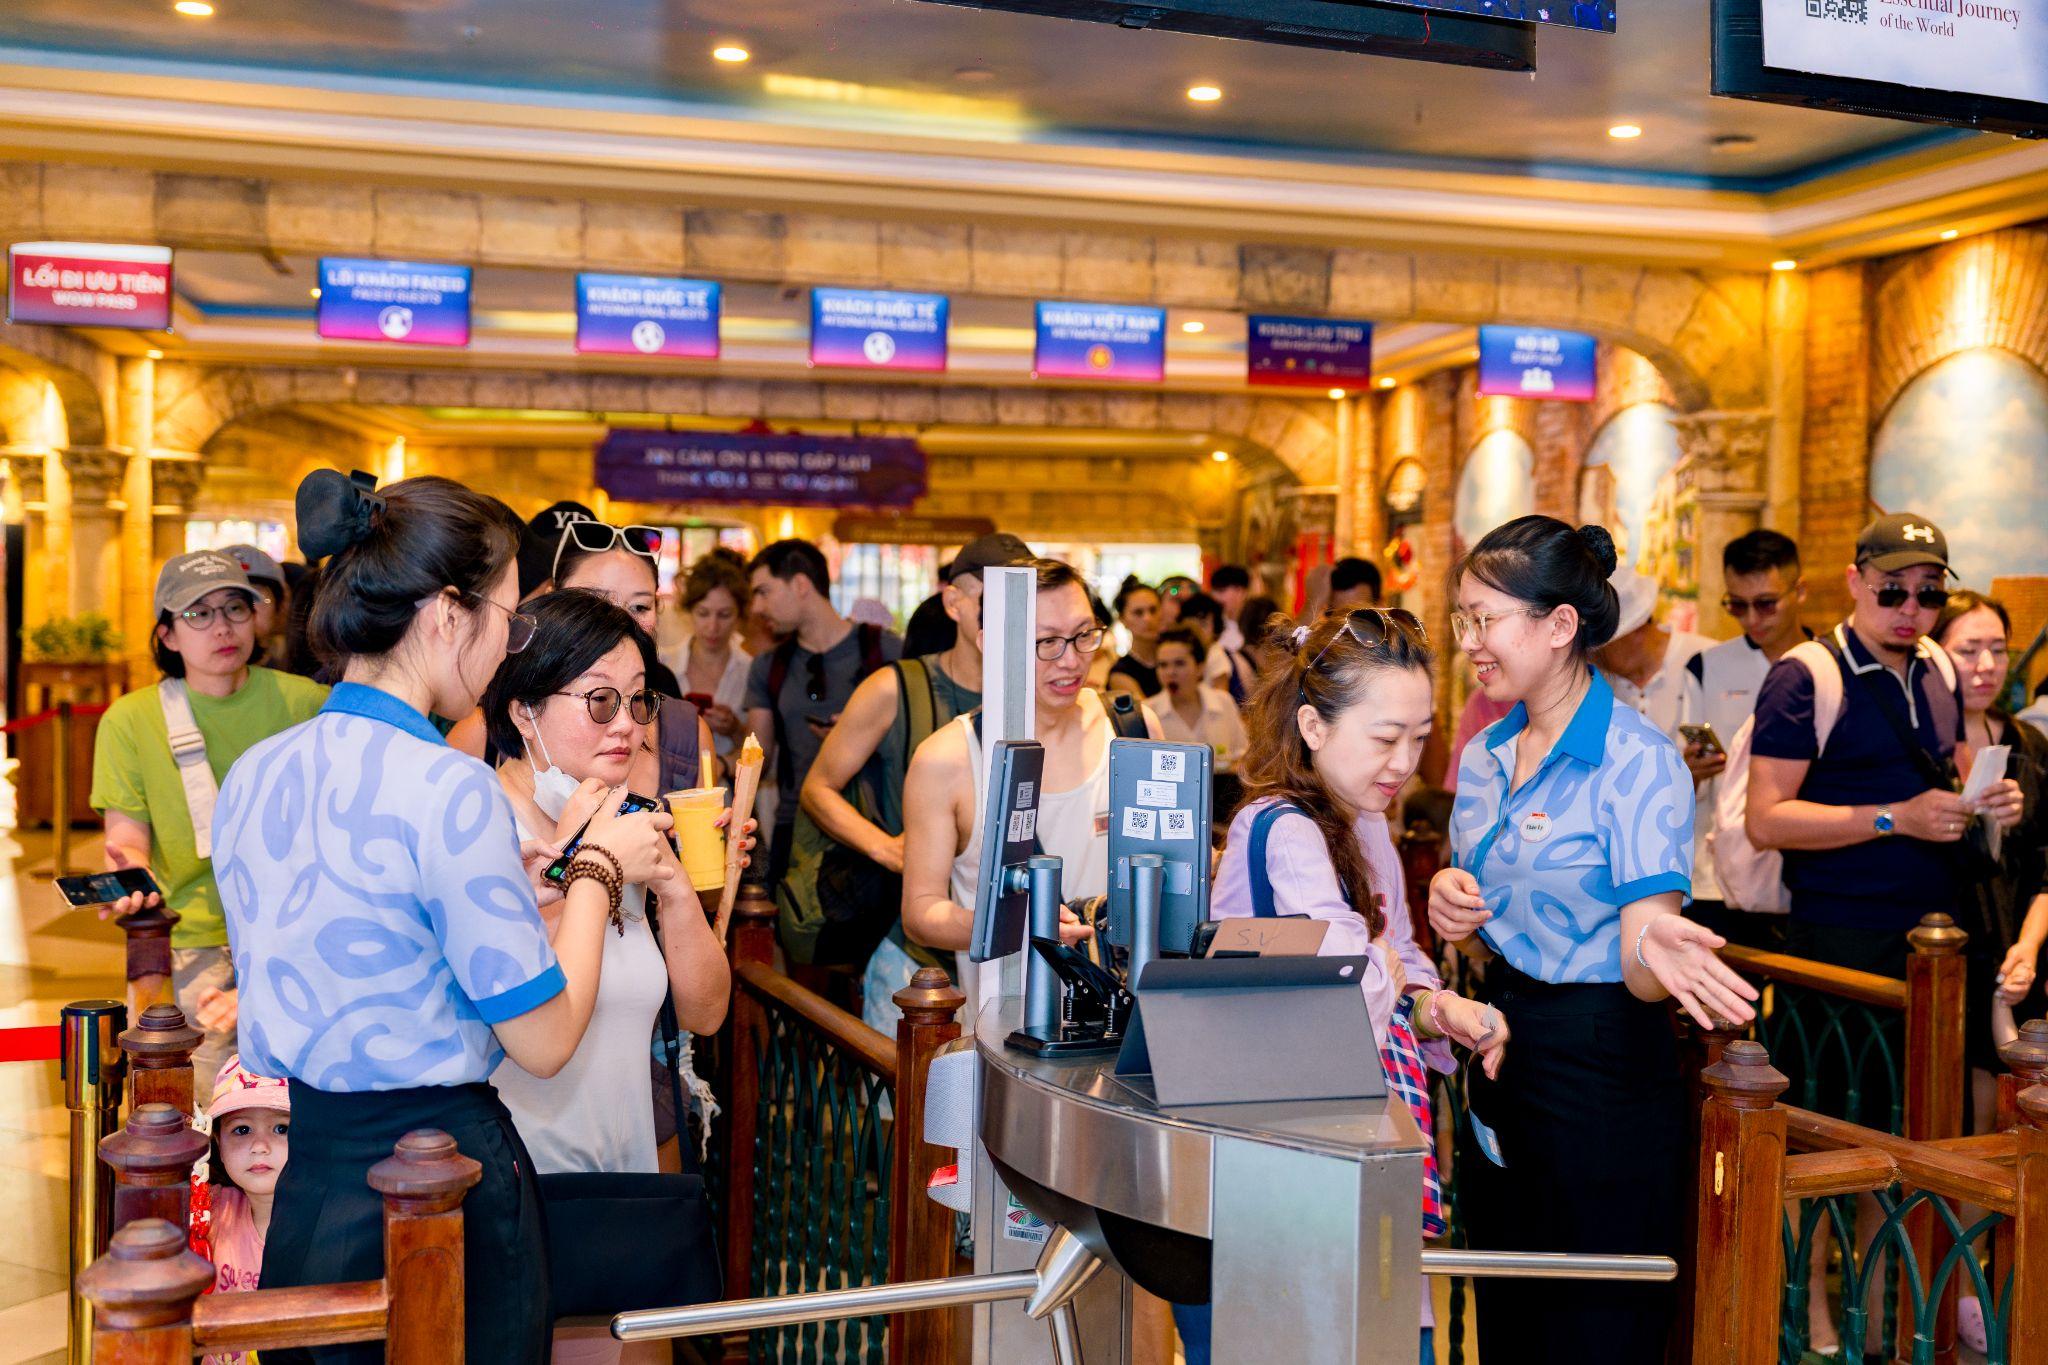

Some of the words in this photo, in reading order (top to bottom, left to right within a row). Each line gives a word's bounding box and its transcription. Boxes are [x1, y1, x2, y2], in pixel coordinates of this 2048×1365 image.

[1880, 0, 1953, 14] sential
[1957, 0, 2020, 30] Journey
[1880, 13, 1894, 27] of
[1895, 14, 1913, 31] the
[1916, 16, 1954, 37] World
